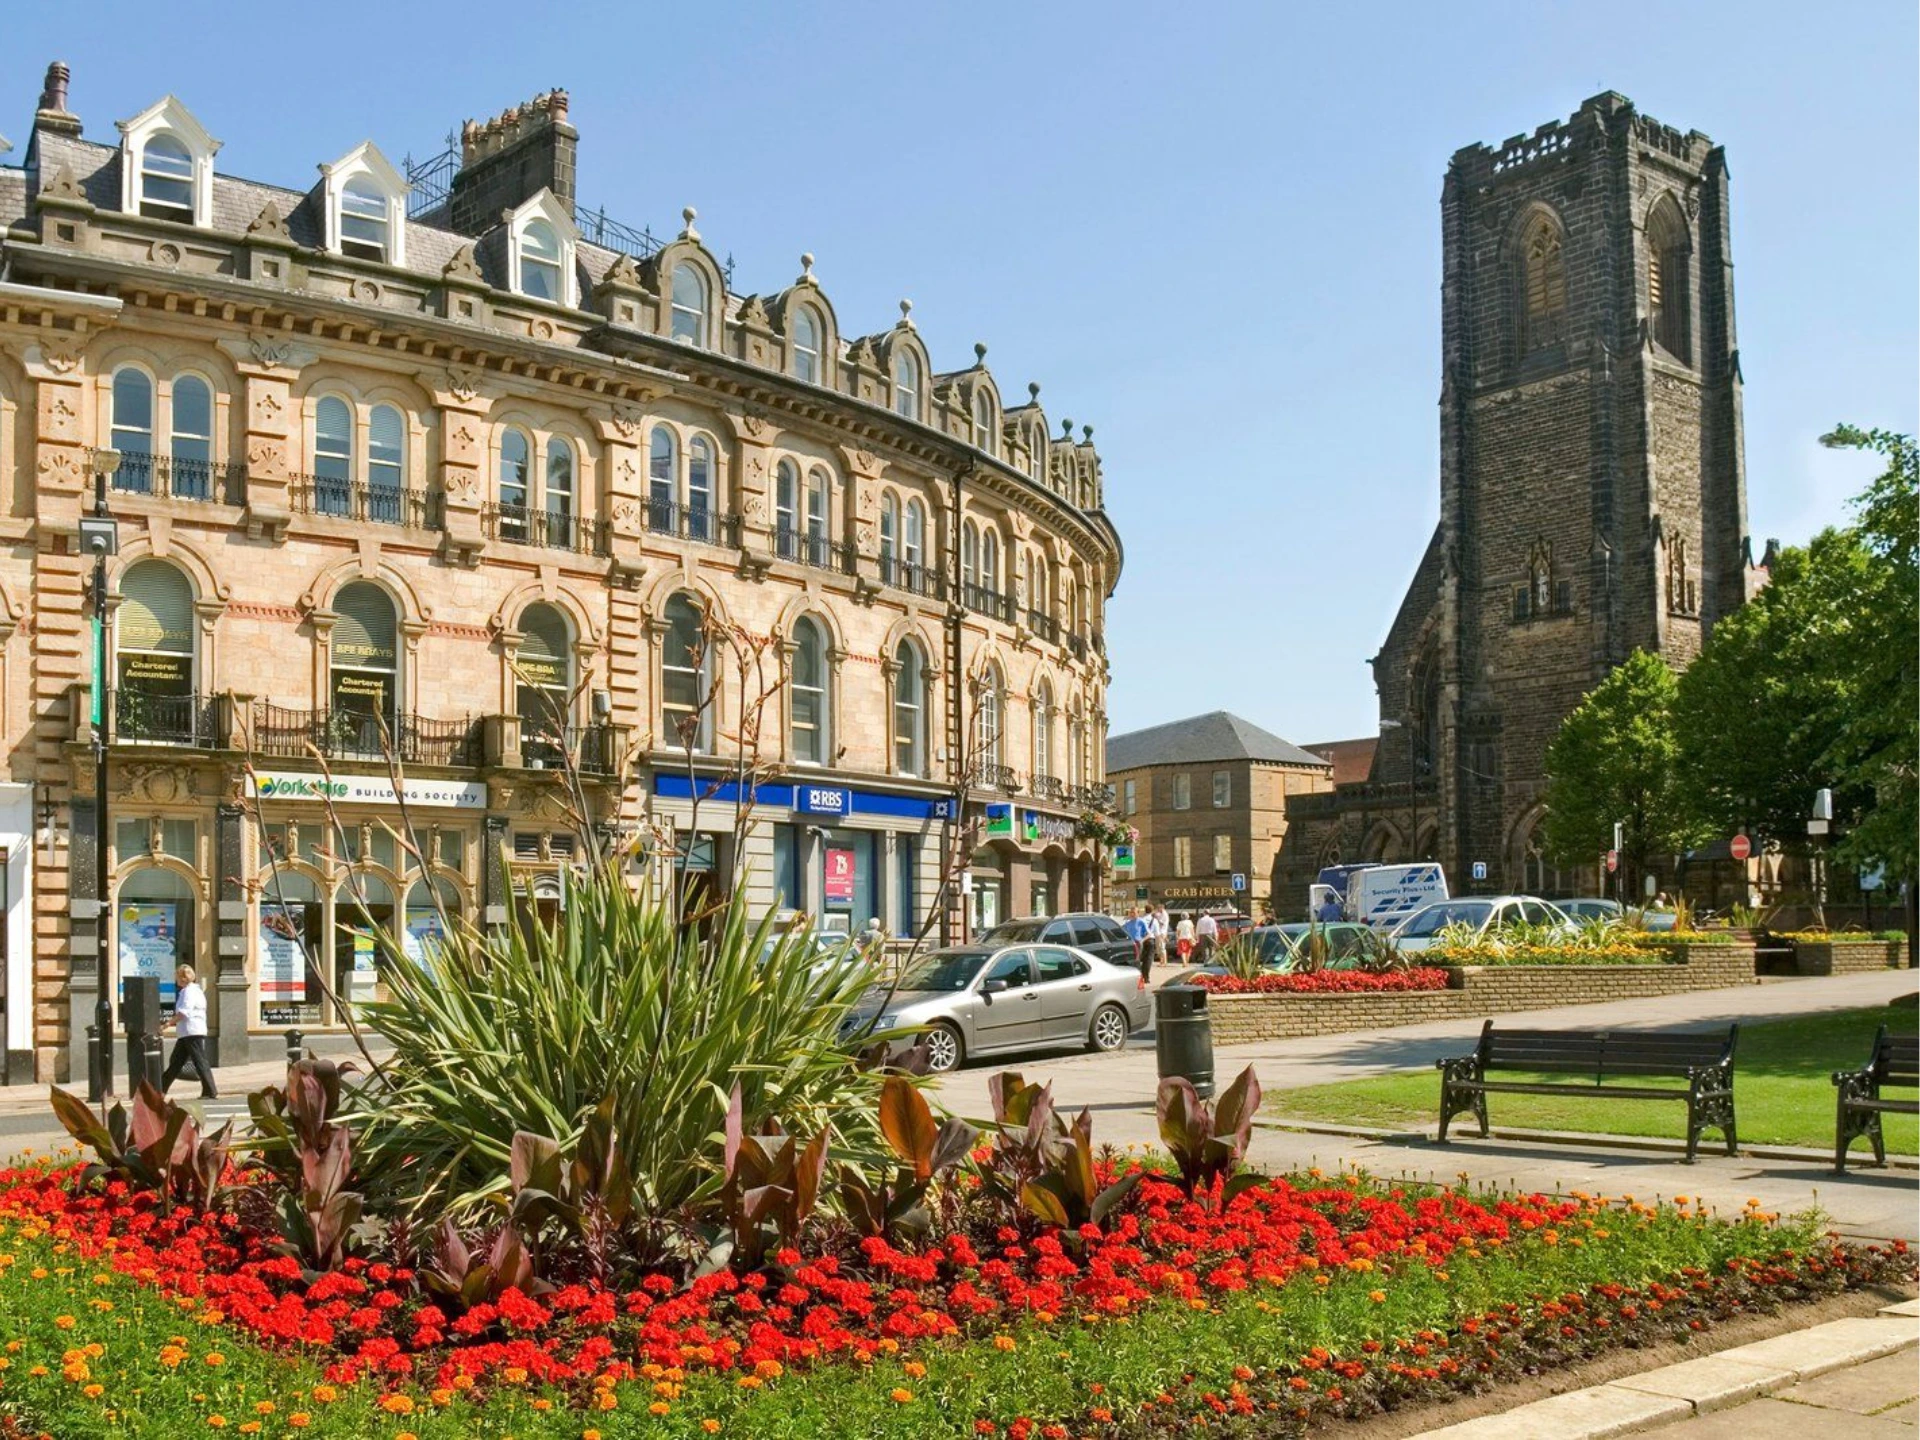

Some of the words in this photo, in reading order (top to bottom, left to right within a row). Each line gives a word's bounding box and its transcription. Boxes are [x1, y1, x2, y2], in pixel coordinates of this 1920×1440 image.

[131, 661, 178, 671] Chartered
[342, 676, 383, 687] Chartered
[356, 788, 418, 799] BUILDNG
[424, 792, 478, 803] SOCIETY
[821, 789, 842, 808] RBS
[1164, 886, 1236, 898] CRABTREES
[1372, 888, 1401, 896] Security
